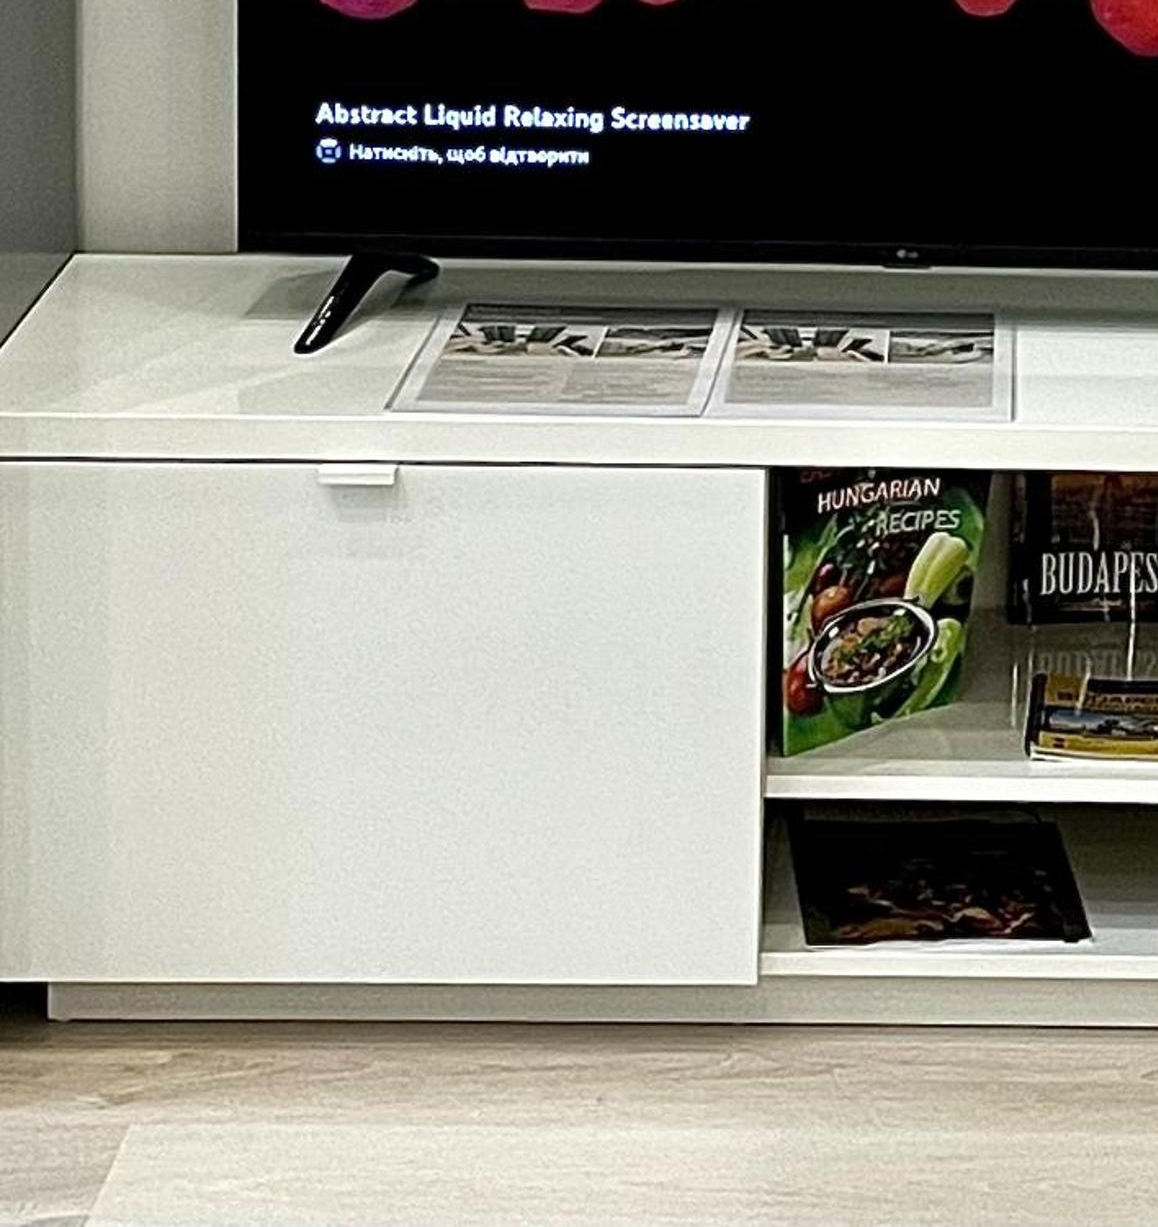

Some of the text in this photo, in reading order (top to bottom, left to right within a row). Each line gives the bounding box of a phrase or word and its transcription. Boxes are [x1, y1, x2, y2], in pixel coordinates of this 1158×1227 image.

[315, 102, 750, 134] Abstract Liquid Relaxing Screensaver
[446, 145, 487, 165] щоб
[489, 147, 590, 168] відтворити
[817, 477, 941, 514] HUNGARIAN
[875, 510, 962, 538] RECIPES
